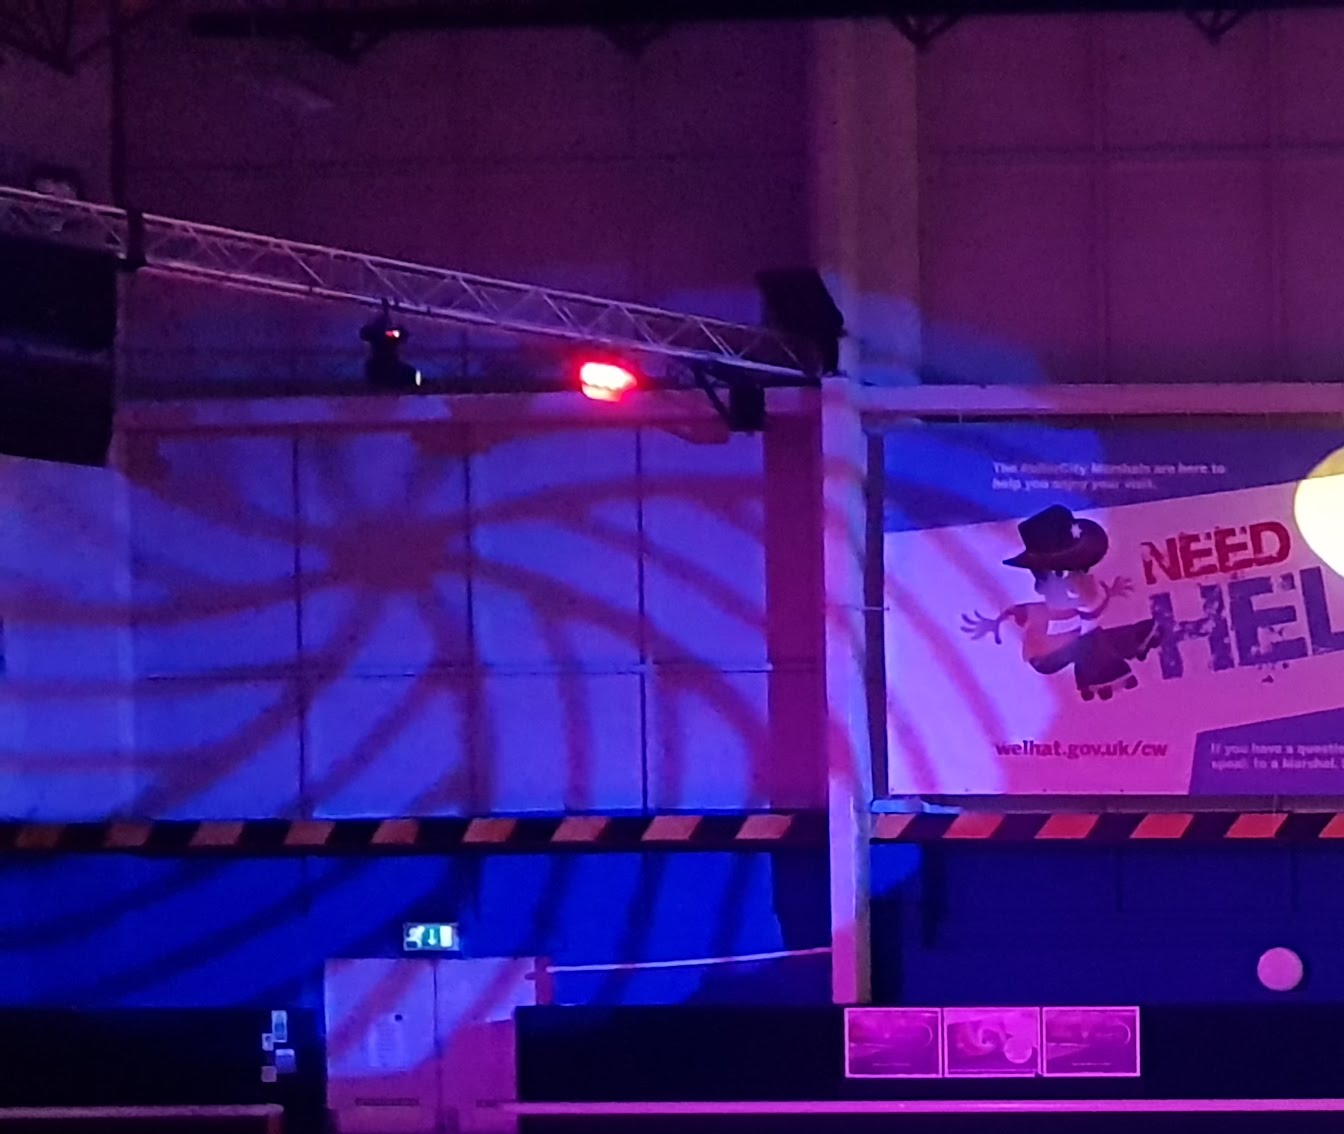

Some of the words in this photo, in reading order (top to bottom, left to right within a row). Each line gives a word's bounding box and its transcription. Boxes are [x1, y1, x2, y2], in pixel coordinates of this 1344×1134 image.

[1178, 461, 1207, 474] here
[1211, 463, 1227, 474] to
[1141, 521, 1291, 585] NEED
[995, 740, 1168, 760] welhat.gov.uk/cw
